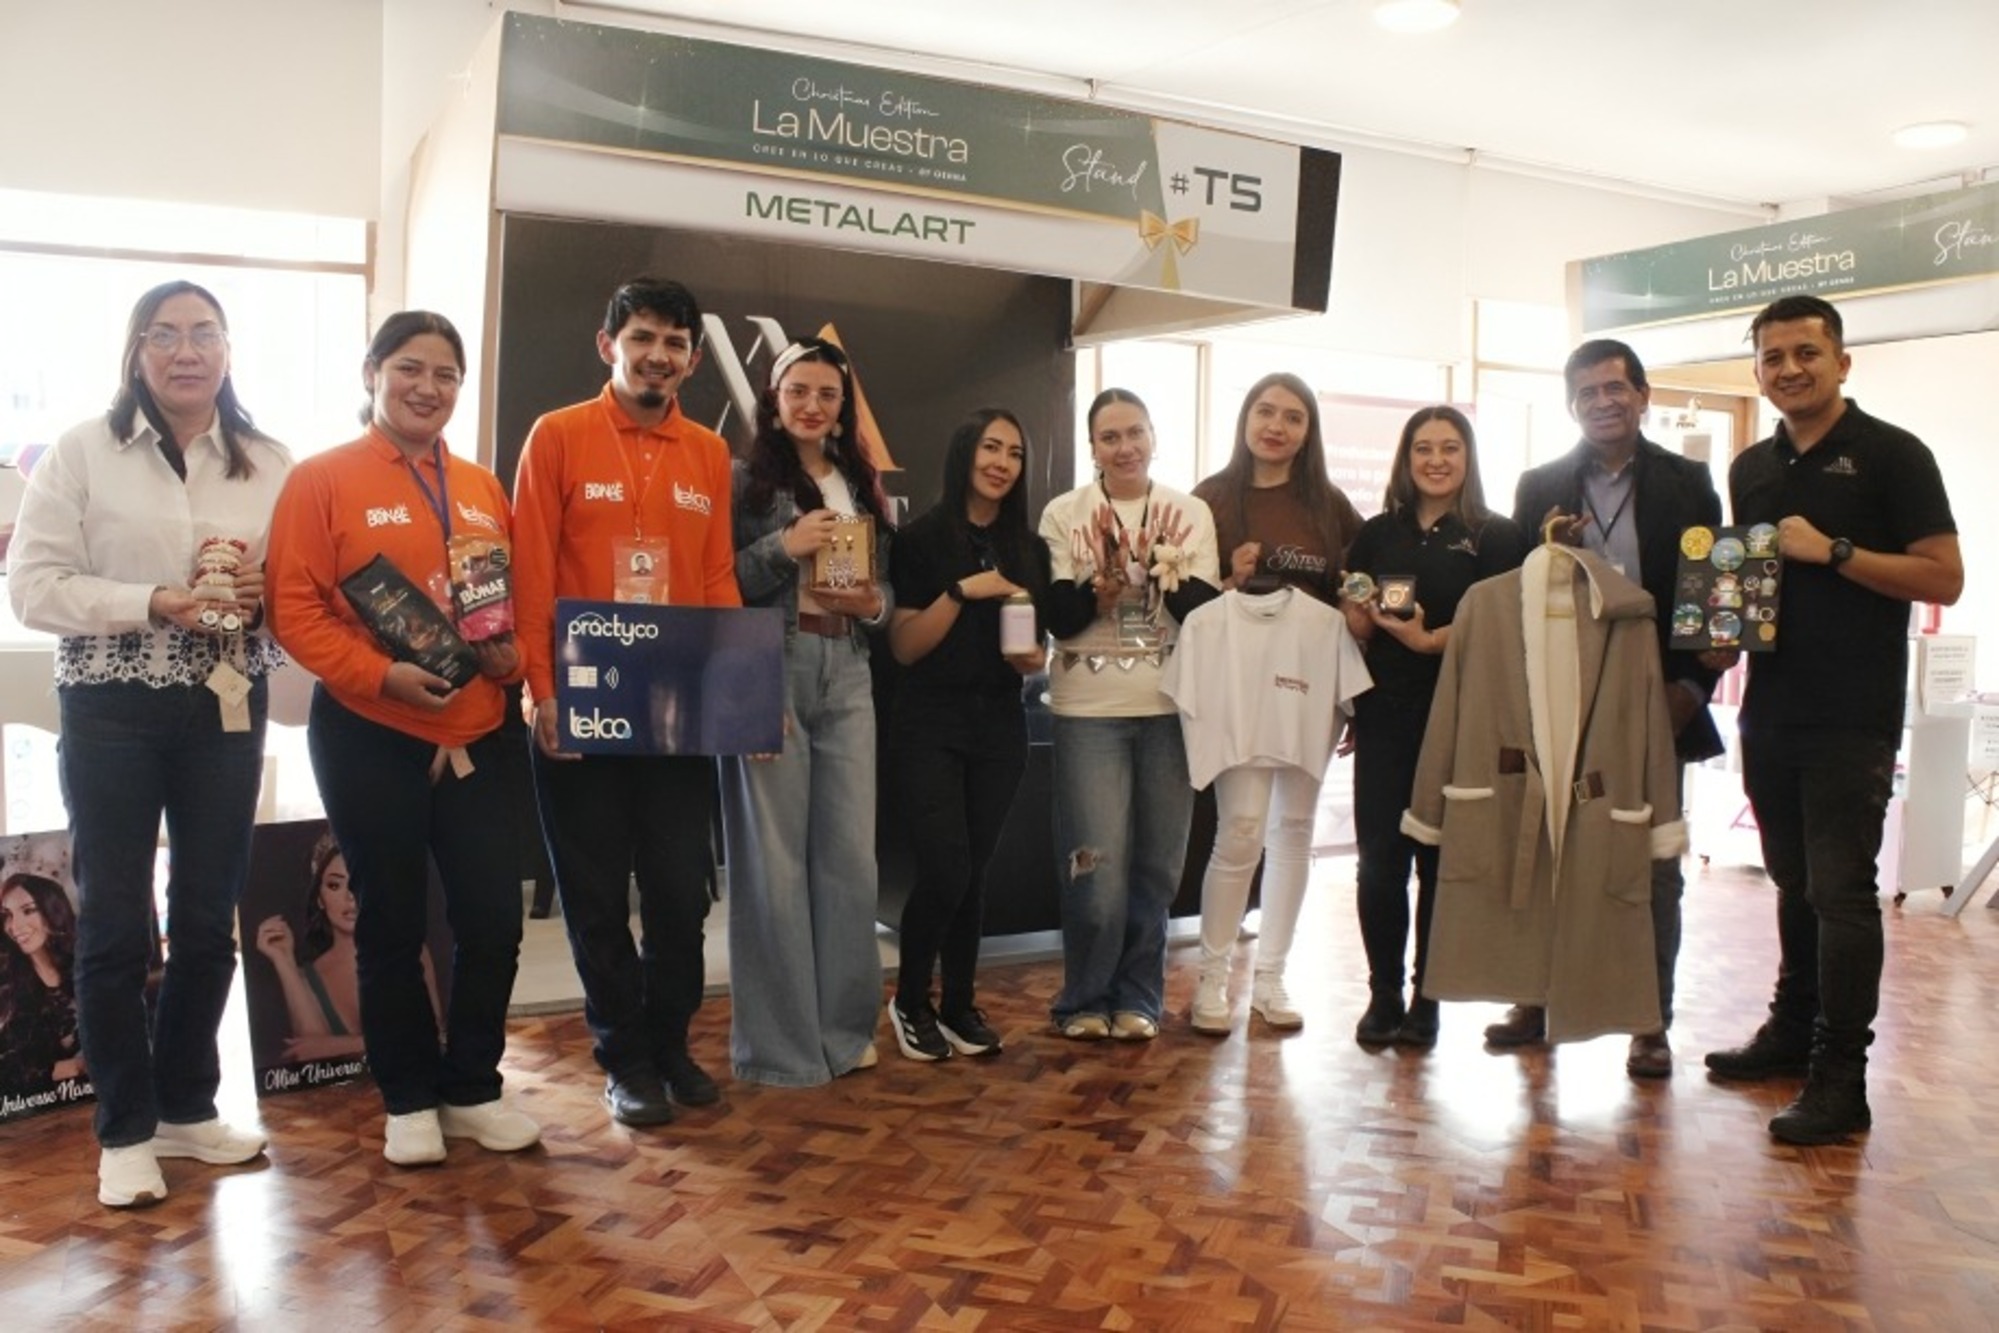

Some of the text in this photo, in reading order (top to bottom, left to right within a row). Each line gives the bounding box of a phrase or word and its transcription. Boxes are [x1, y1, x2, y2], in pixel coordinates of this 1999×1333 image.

[791, 77, 940, 120] Christmas Edition
[753, 99, 968, 164] La Muestra
[864, 159, 904, 174] CREAS
[1060, 143, 1148, 201] Stand
[746, 190, 976, 244] METALART
[1932, 219, 1999, 267] Stan
[1708, 249, 1856, 291] La Muestra
[569, 707, 633, 739] telco
